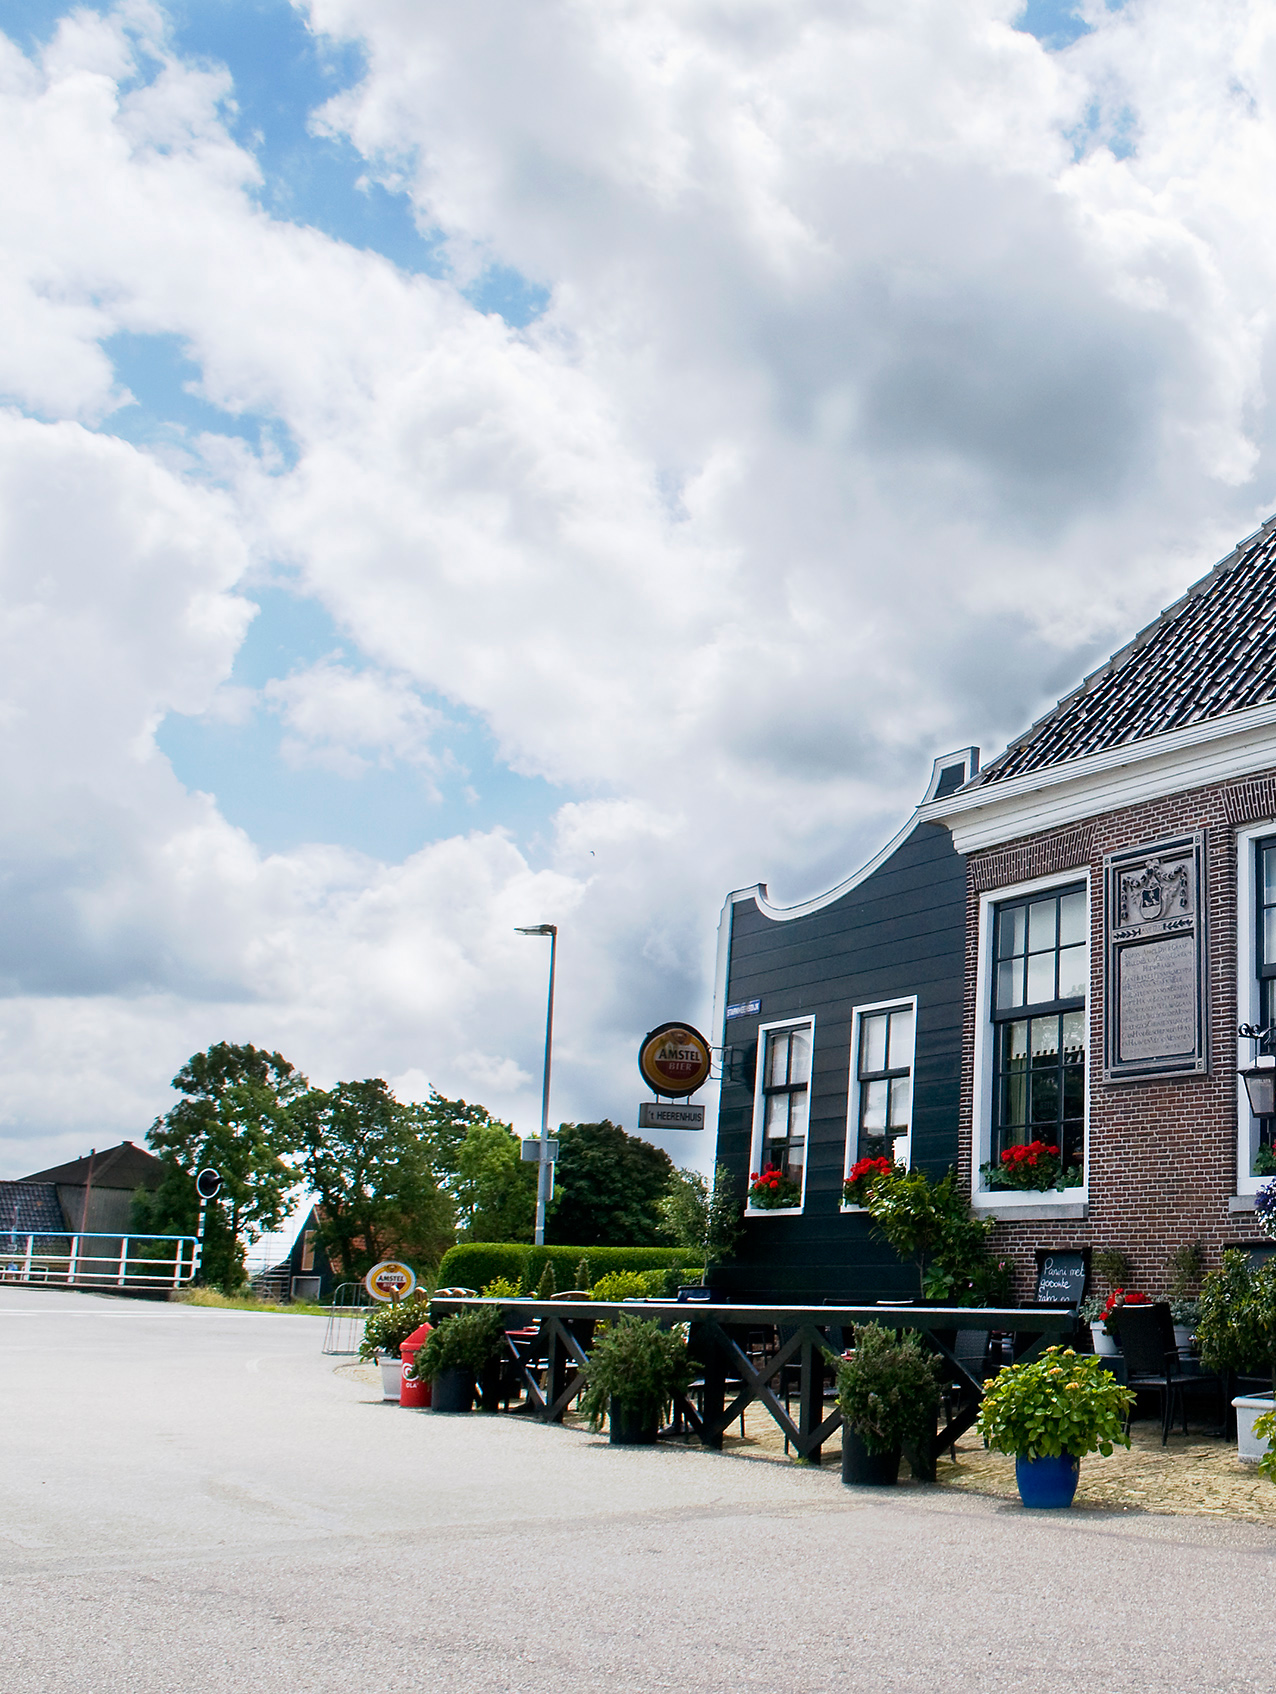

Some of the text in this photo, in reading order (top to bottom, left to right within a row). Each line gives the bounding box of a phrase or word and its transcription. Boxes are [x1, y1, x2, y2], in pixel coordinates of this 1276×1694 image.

[658, 1049, 700, 1061] AMSTEL
[668, 1062, 692, 1070] BIER
[656, 1111, 702, 1121] HEERENHUIS
[1069, 1261, 1086, 1277] met
